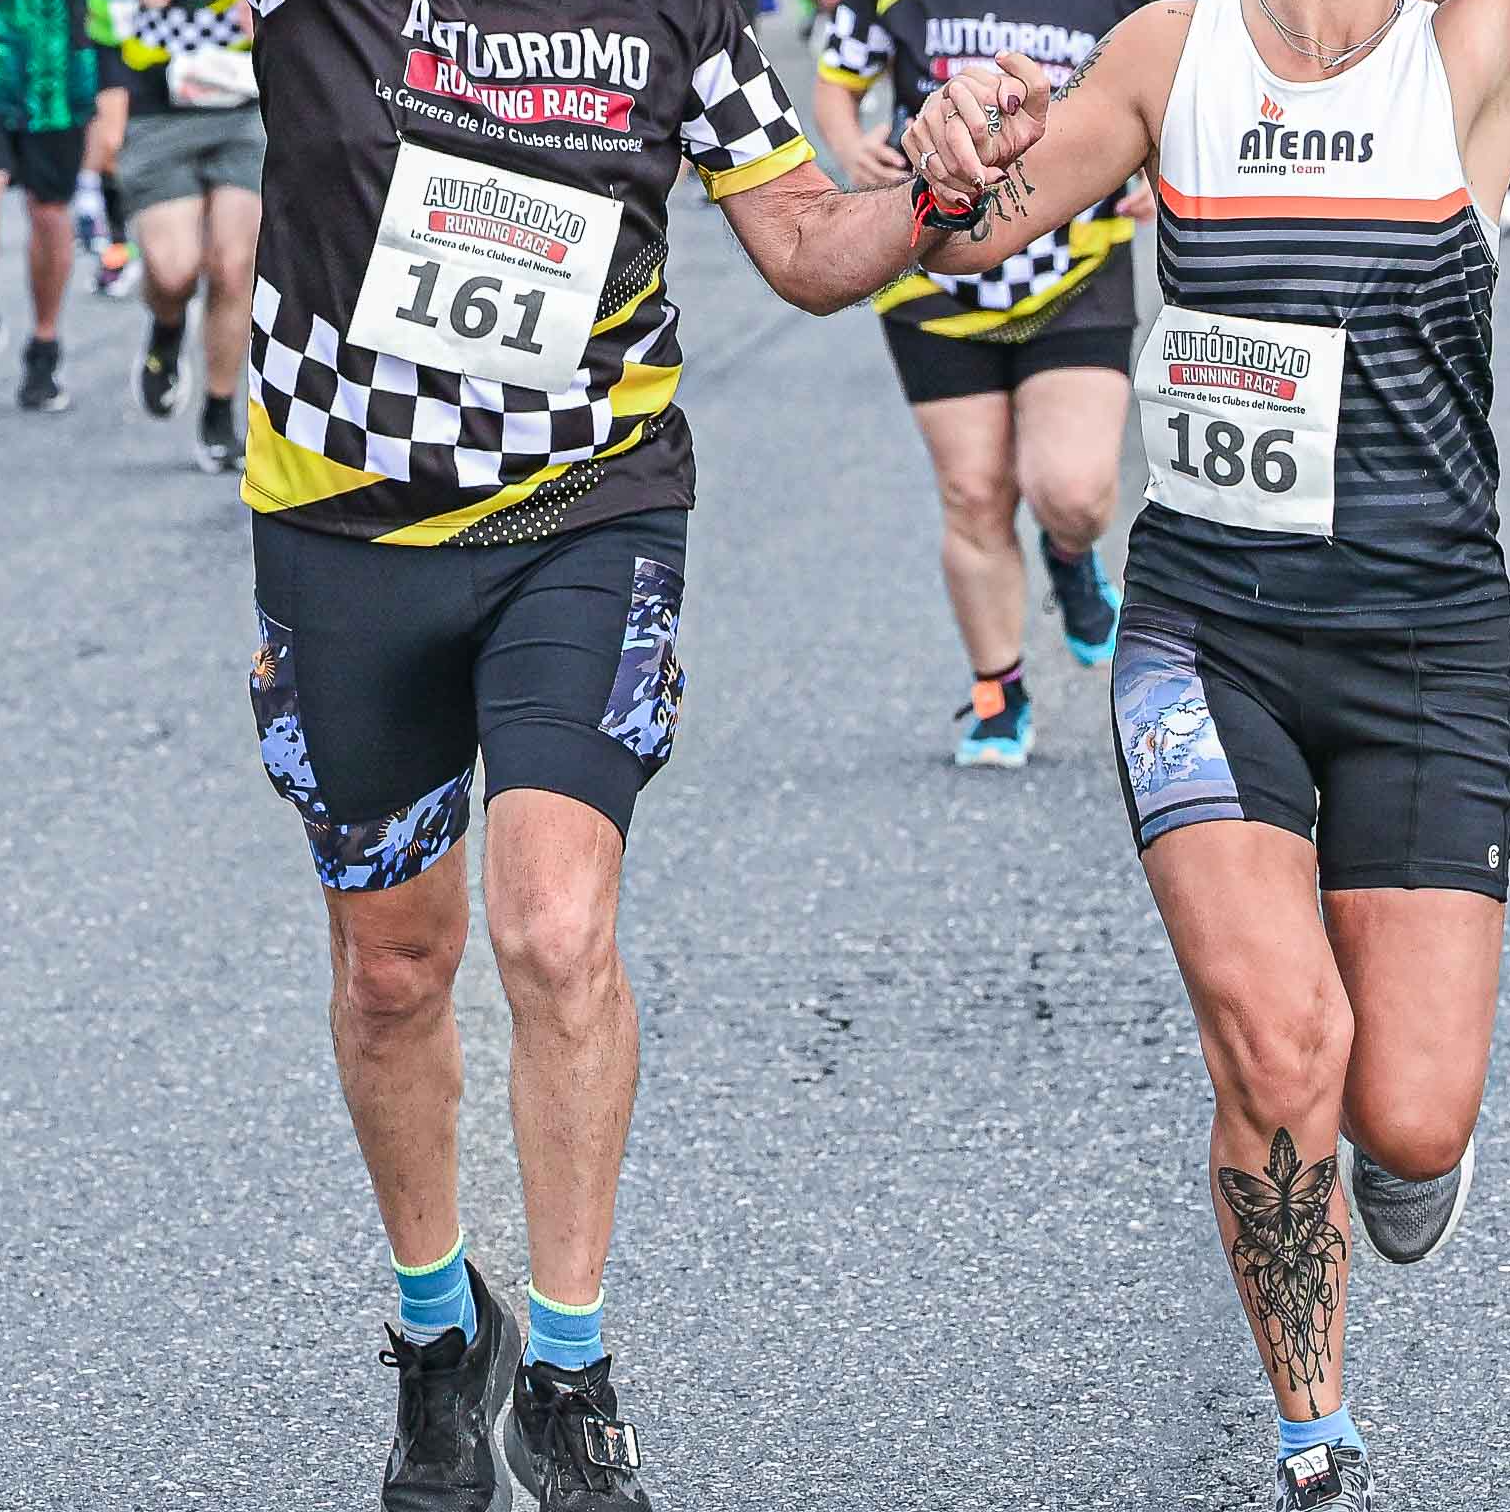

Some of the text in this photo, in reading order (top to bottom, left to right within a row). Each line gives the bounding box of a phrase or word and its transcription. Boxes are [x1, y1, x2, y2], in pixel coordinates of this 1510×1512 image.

[375, 78, 392, 102] La
[395, 87, 454, 125] Carrera
[456, 112, 478, 133] de
[481, 118, 505, 140] los
[508, 128, 562, 149] Clubes
[564, 133, 589, 151] del
[542, 88, 611, 124] RACE
[1239, 121, 1374, 163] ATENAS
[1237, 162, 1325, 176] running team
[423, 177, 587, 244] AUTÓDROMO
[410, 229, 572, 281] La Carrera de los Clubes del Noroeste
[444, 215, 553, 257] RUNNING RACE
[395, 260, 547, 356] 161
[1163, 325, 1311, 379] AUTÓDROMO
[1158, 385, 1306, 415] La Carrera de los Clubes del Noroeste
[1181, 367, 1281, 396] RUNNING RACE
[1167, 412, 1298, 494] 186
